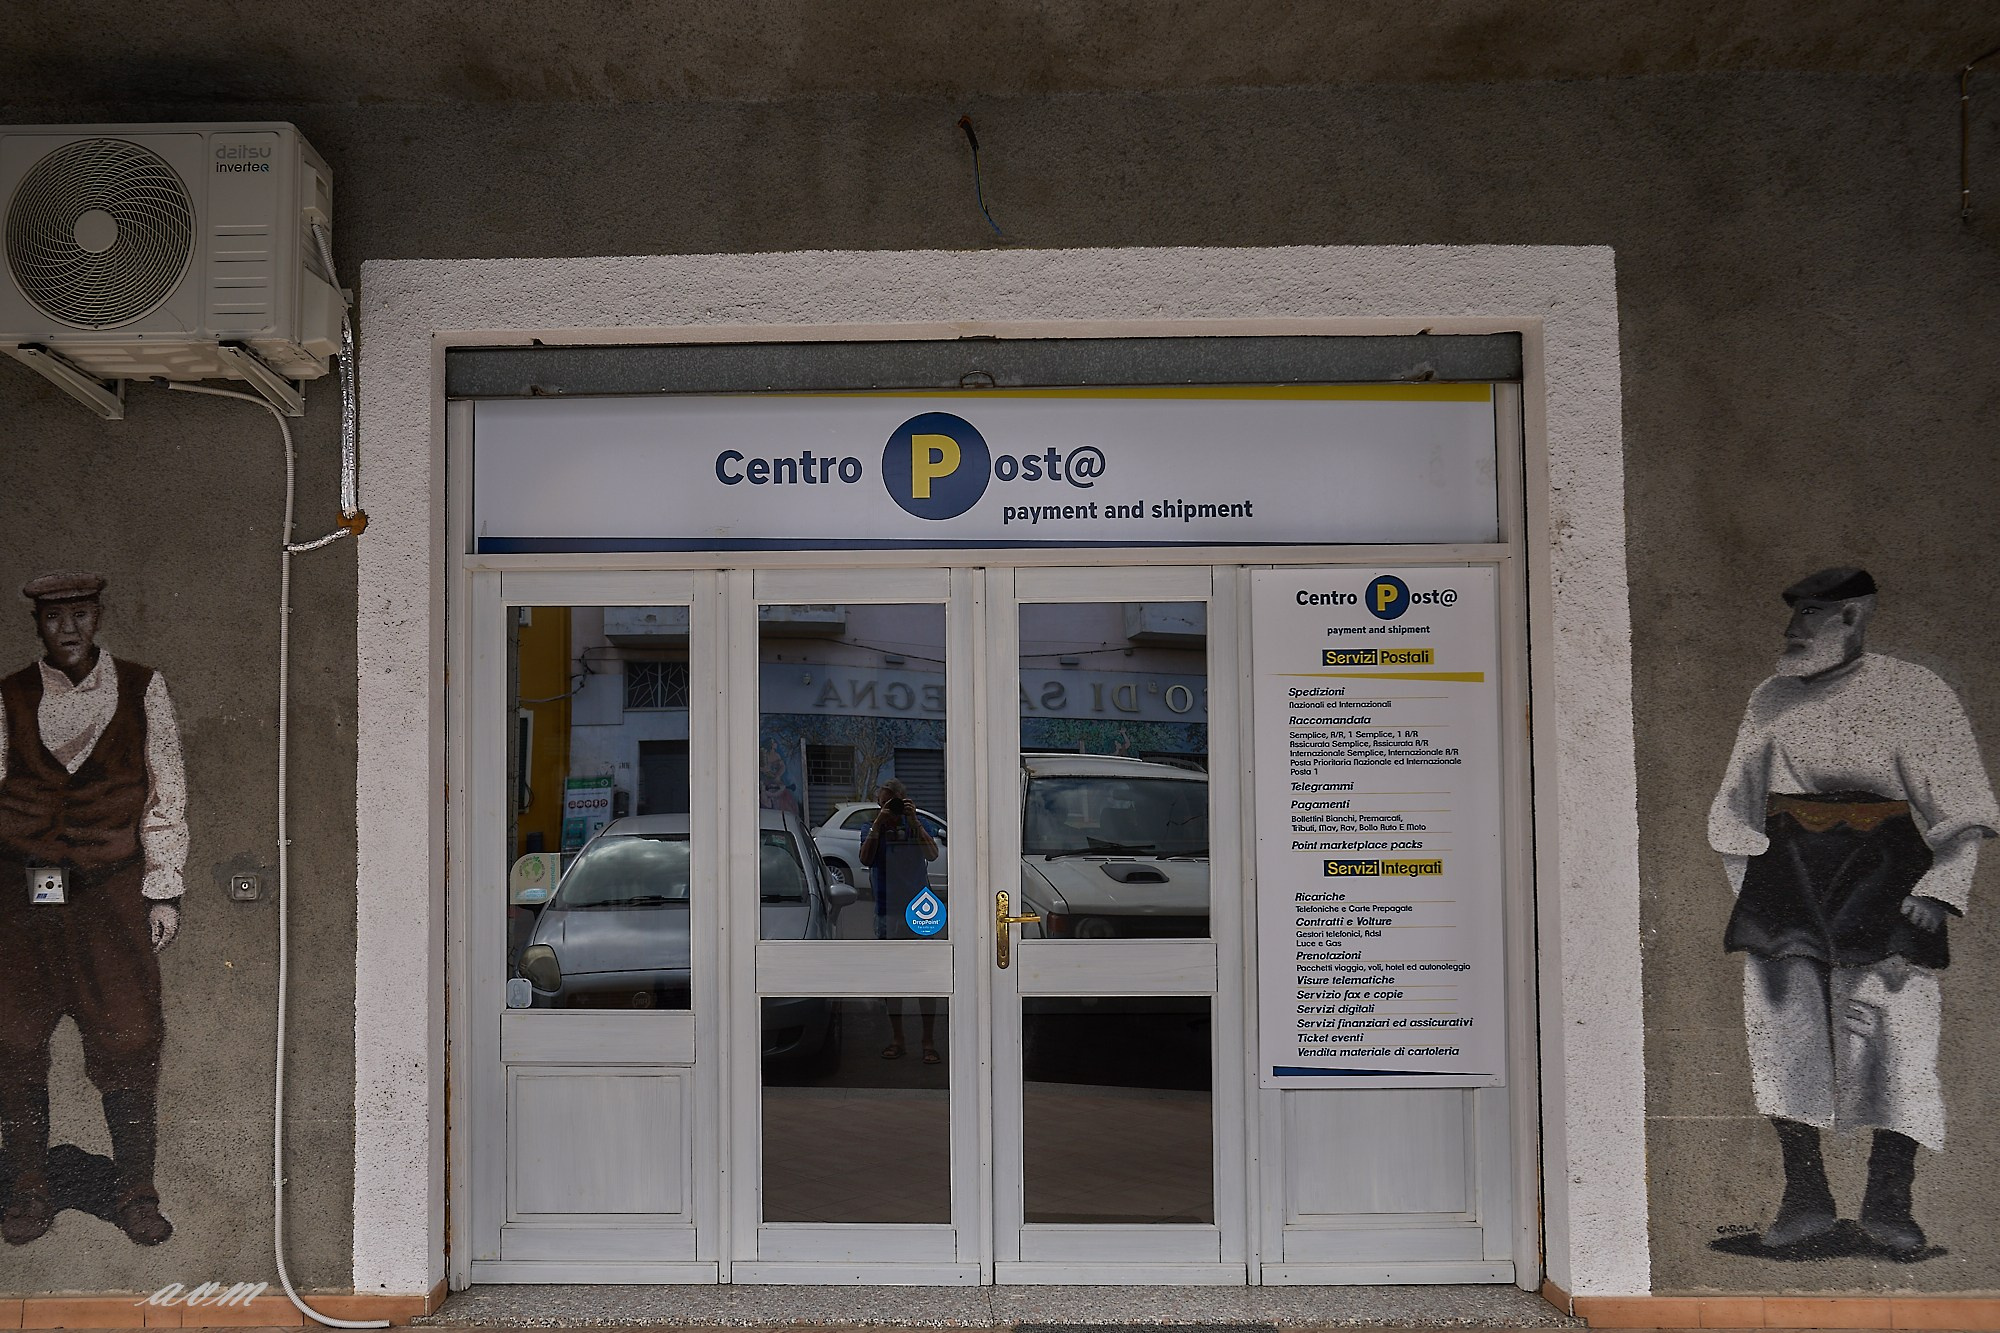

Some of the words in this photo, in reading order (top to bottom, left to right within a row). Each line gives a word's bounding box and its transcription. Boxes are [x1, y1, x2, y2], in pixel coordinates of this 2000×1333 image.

[216, 144, 271, 159] daitsu
[715, 449, 863, 485] Centro
[1003, 502, 1098, 525] payment
[1104, 501, 1144, 519] and
[1151, 499, 1253, 523] shipment
[1296, 590, 1358, 606] Centro
[1327, 626, 1366, 636] payment
[1388, 625, 1430, 635] shipment
[1326, 651, 1375, 664] Servizi
[1382, 651, 1428, 663] Postali
[1289, 687, 1345, 698] Spedizioni
[1289, 716, 1371, 725] Raccomandata
[1290, 731, 1328, 740] Semplice,
[1356, 731, 1395, 739] Semplice,
[1332, 740, 1371, 748] Semplice,
[1347, 750, 1386, 758] Semplice,
[1291, 782, 1354, 792] Telegrammi
[1291, 800, 1350, 811] Pagamenti
[1326, 815, 1357, 823] Bianchi,
[1359, 815, 1403, 823] Premarcati,
[1292, 841, 1317, 849] Point
[1320, 841, 1388, 851] marketplace
[1391, 840, 1423, 850] packs
[1328, 862, 1377, 875] Servizi
[1382, 861, 1442, 877] Integrati
[1295, 892, 1345, 901] Ricariche
[1373, 905, 1412, 913] Prepagate
[1296, 917, 1344, 926] Contratti
[1357, 917, 1392, 926] Volture
[1296, 951, 1361, 960] Prenotazioni
[1334, 964, 1366, 972] viaggio,
[1420, 963, 1470, 971] autonoleggio
[1297, 976, 1329, 984] Visure
[1332, 975, 1395, 984] telematiche
[1297, 990, 1341, 999] Servizio
[1344, 990, 1361, 1001] fax
[1374, 990, 1403, 1000] copie
[1297, 1005, 1335, 1013] Servizi
[1338, 1004, 1375, 1015] digitali
[1297, 1019, 1335, 1028] Servizi
[1337, 1019, 1389, 1029] finanziari
[1393, 1018, 1407, 1027] ed
[1409, 1018, 1473, 1027] assicurativi
[1298, 1034, 1328, 1042] Ticket
[1331, 1033, 1364, 1042] eventi
[1298, 1048, 1336, 1056] Vendita
[1340, 1048, 1391, 1056] materiale
[1394, 1047, 1406, 1055] di
[1408, 1047, 1459, 1055] cartoleria
